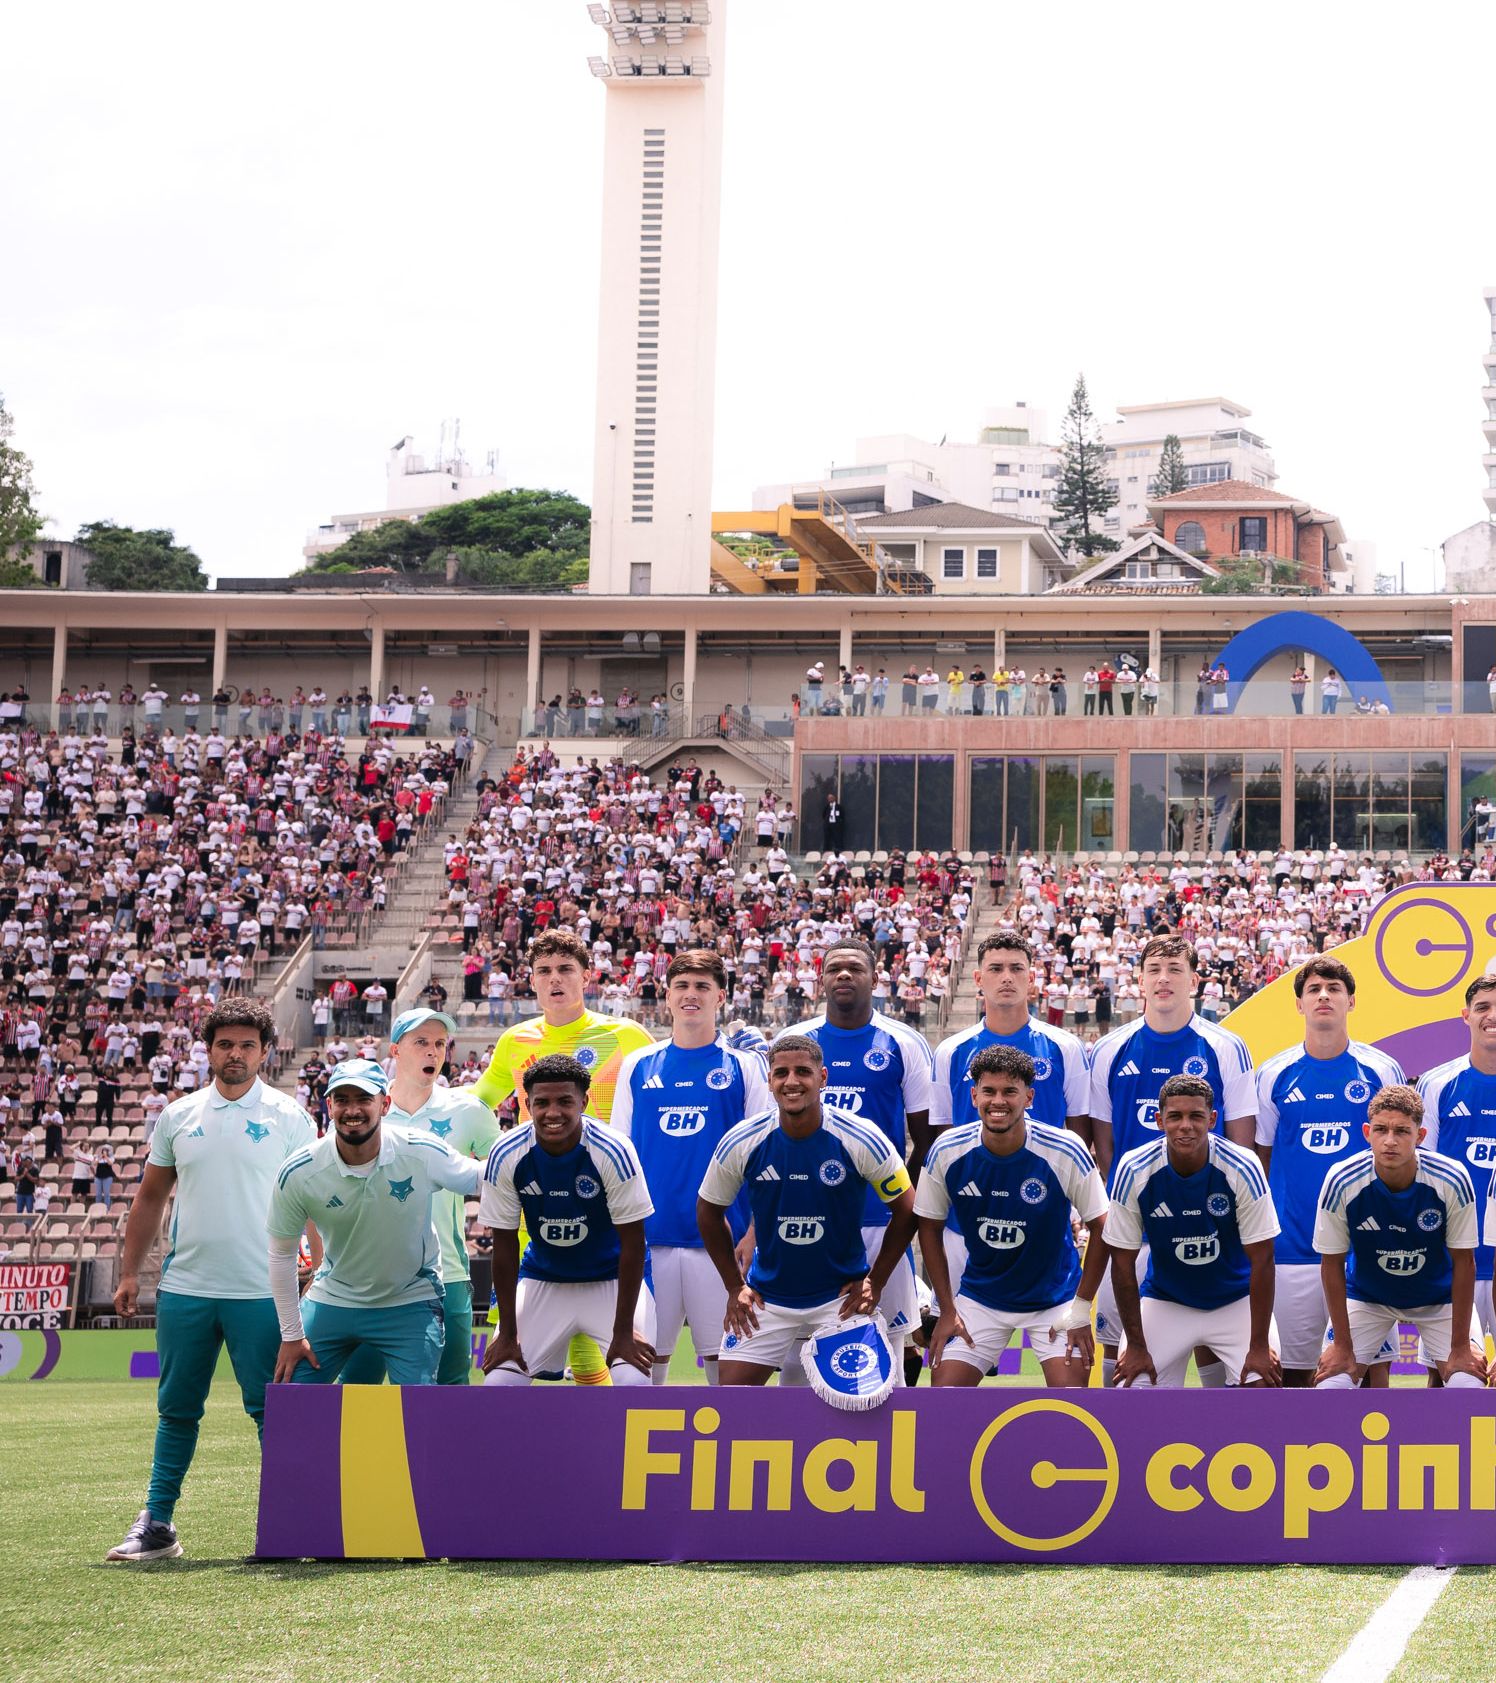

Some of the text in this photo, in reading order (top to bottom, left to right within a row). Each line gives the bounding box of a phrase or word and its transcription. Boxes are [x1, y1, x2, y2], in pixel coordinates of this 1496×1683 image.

[666, 1113, 699, 1130] BH
[1144, 1106, 1159, 1122] B
[1310, 1130, 1342, 1146] BH
[881, 1174, 903, 1196] C
[976, 1217, 1027, 1226] SUPERMERCADOS
[547, 1224, 581, 1240] BH
[785, 1222, 817, 1239] BH
[986, 1224, 1018, 1243] BH
[1184, 1240, 1216, 1260] BH
[1386, 1256, 1419, 1271] BH
[621, 1407, 926, 1513] Final
